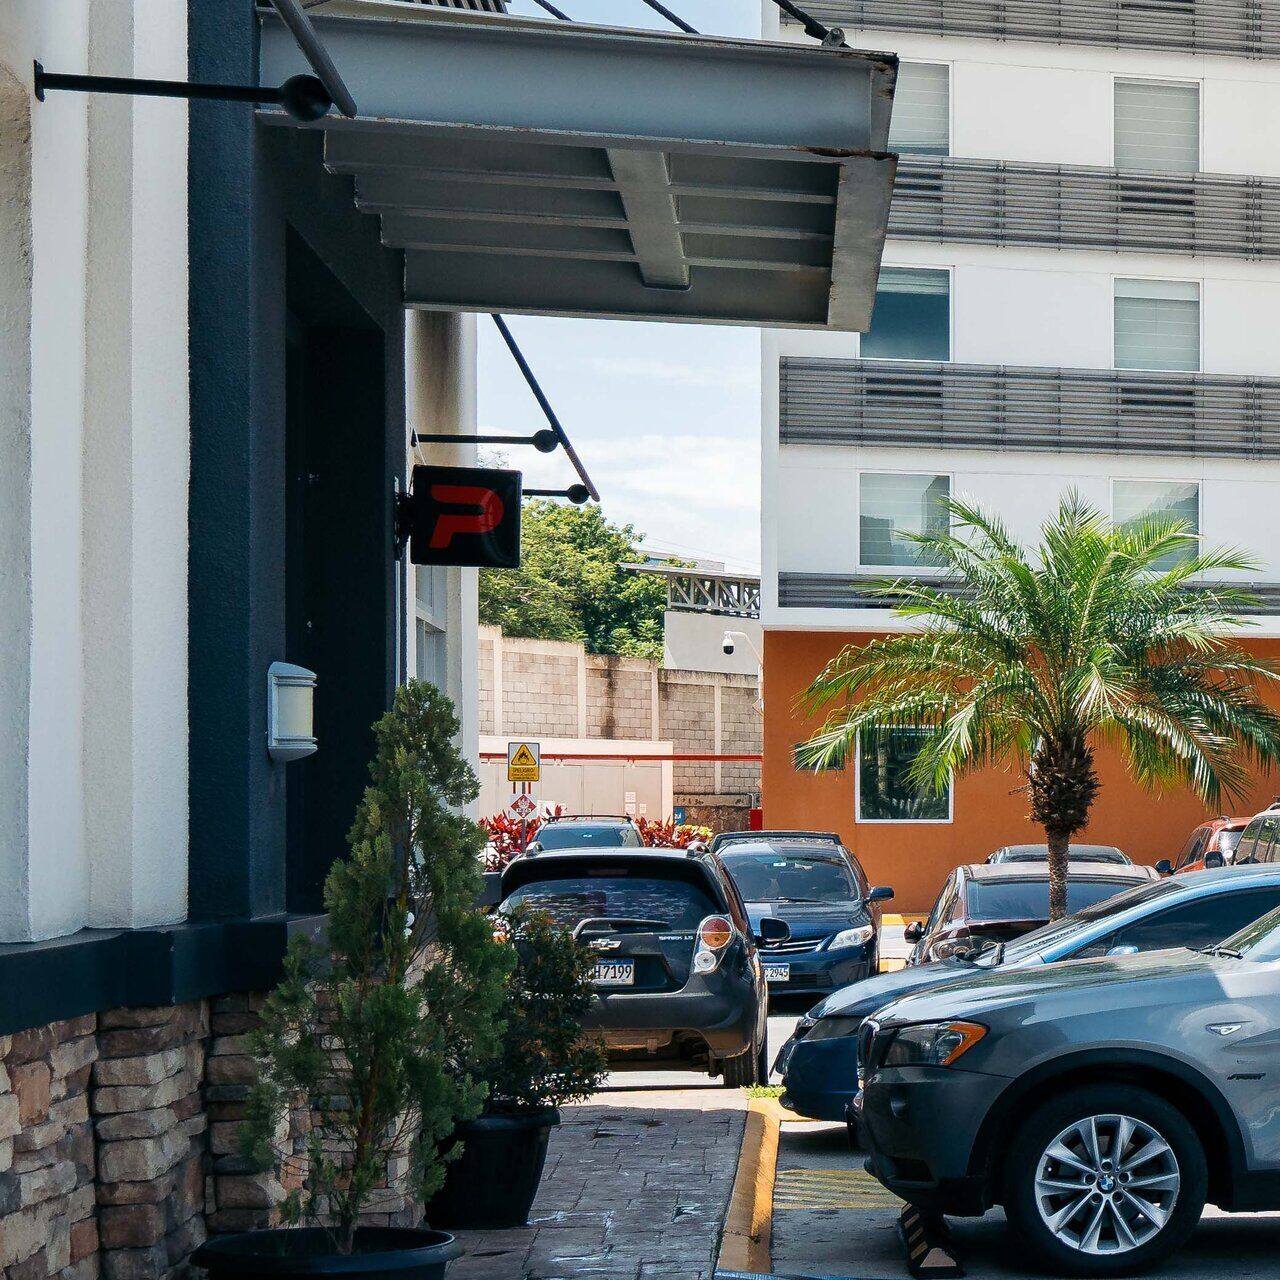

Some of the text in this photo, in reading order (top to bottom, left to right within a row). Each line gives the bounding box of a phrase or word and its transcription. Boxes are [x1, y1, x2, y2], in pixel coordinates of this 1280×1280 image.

[428, 485, 505, 549] P
[603, 965, 632, 979] 7199
[770, 968, 788, 978] 2945
